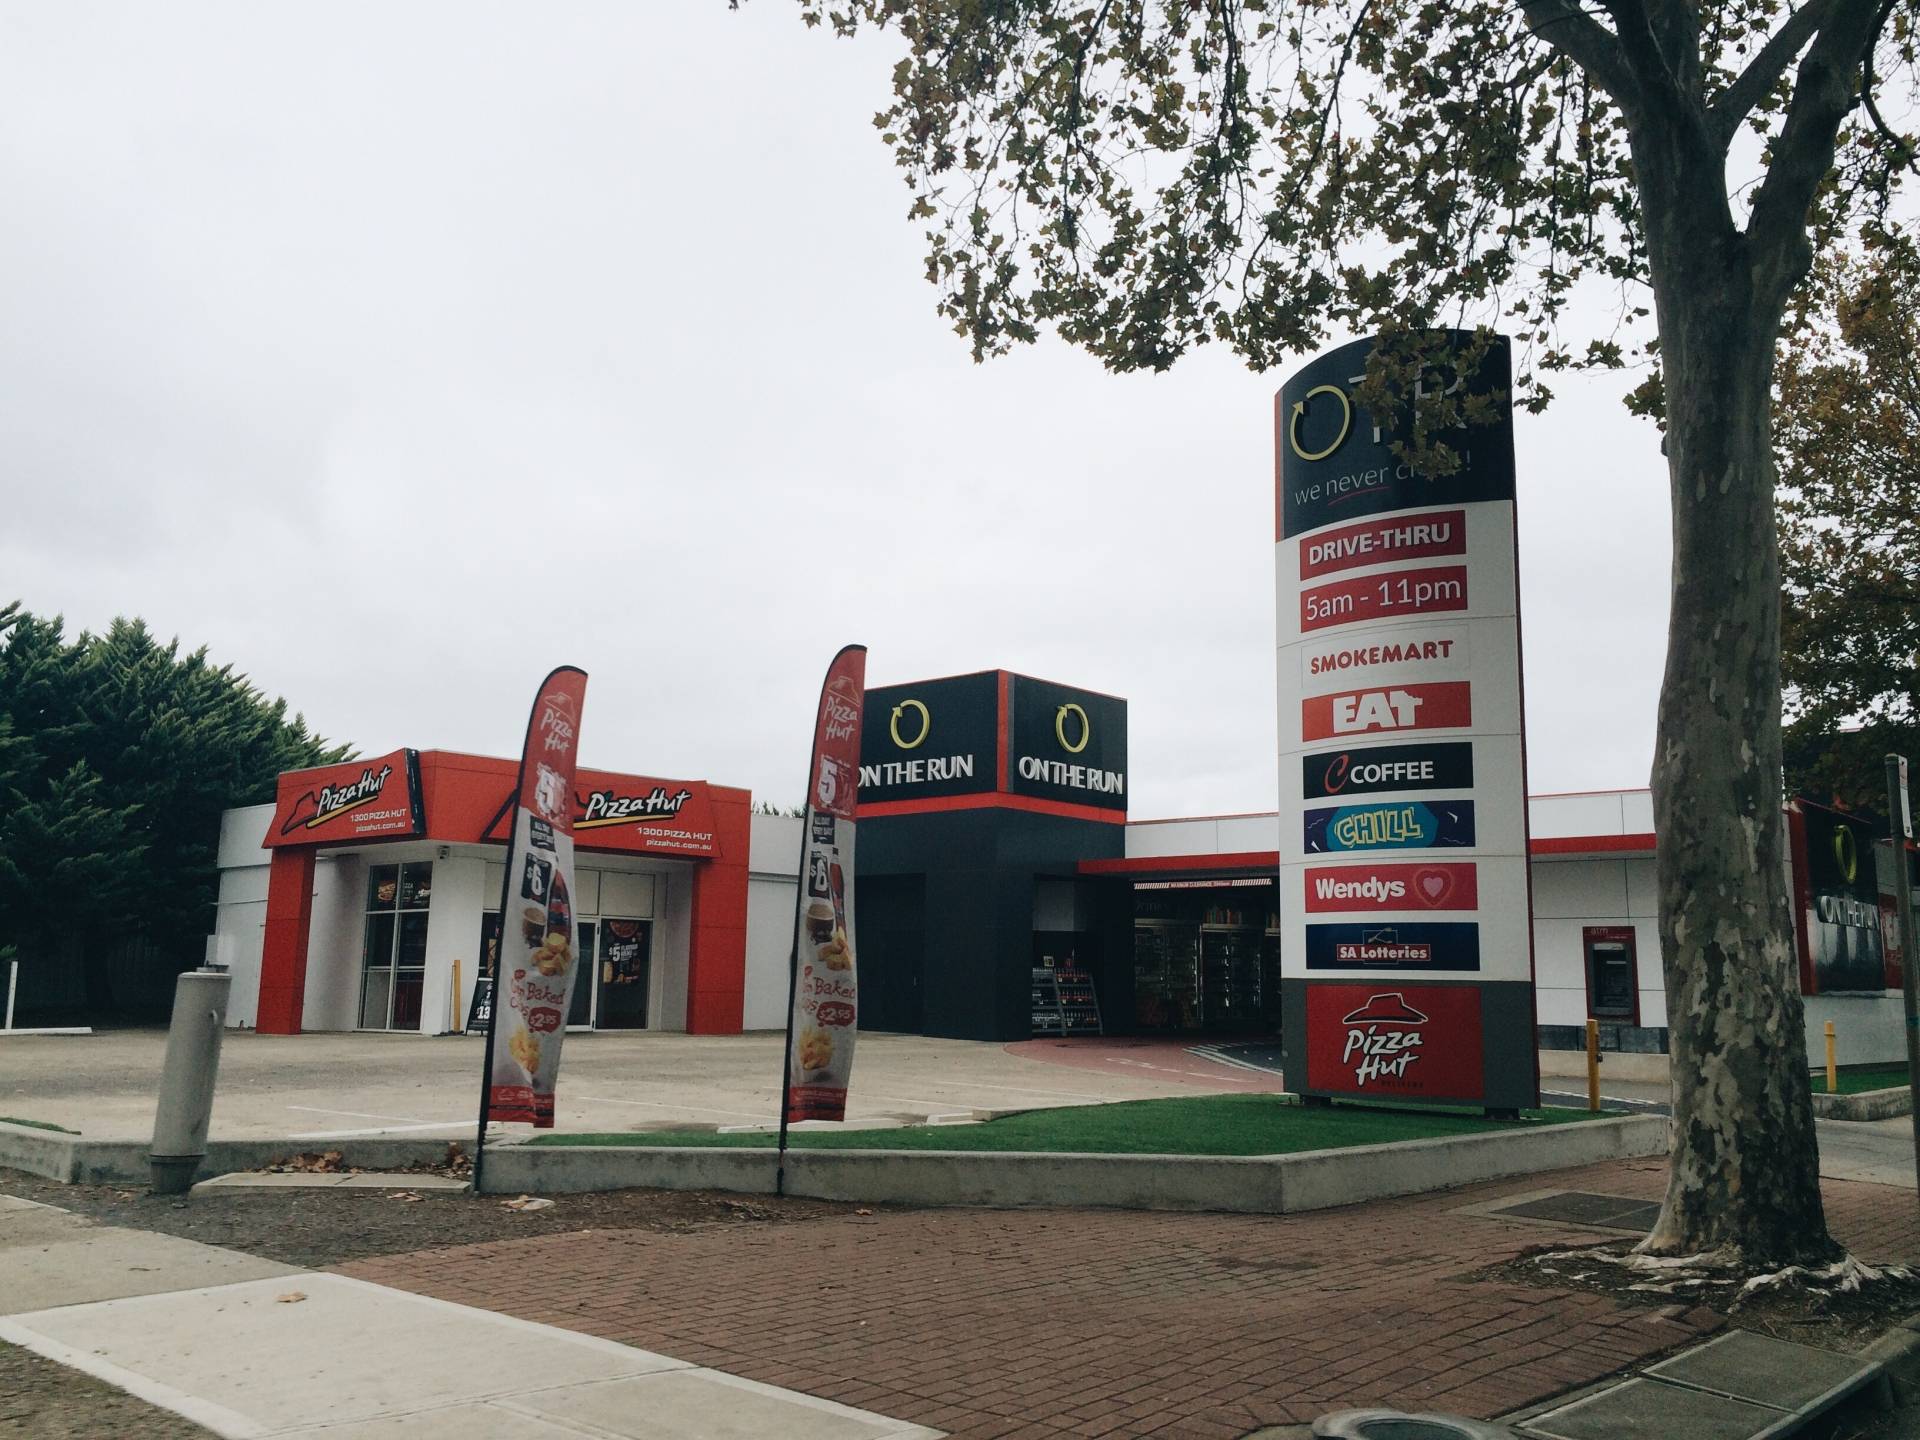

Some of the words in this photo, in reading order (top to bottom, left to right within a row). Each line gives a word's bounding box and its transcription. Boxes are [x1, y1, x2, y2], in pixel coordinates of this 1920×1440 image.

[1295, 484, 1321, 505] we
[1326, 467, 1389, 497] never
[1309, 522, 1451, 566] DRIVE-THRU
[1306, 594, 1353, 621] 5am
[1378, 578, 1461, 607] 11pm
[1310, 640, 1454, 675] SMOKEMART
[540, 708, 574, 739] Pizza
[823, 696, 858, 723] Pizza
[1333, 690, 1424, 734] EAT
[544, 731, 570, 752] Hut
[825, 720, 856, 742] Hut
[1350, 760, 1434, 784] COFFEE
[317, 783, 358, 818] Pizza
[358, 765, 392, 798] Hut
[585, 790, 643, 820] Pizza
[647, 787, 692, 813] Hut
[350, 812, 369, 822] 1300
[391, 808, 407, 817] HUT
[1334, 807, 1424, 848] CHILL
[637, 827, 662, 836] 1300
[664, 829, 691, 839] PIZZA
[693, 832, 712, 840] HUT
[646, 839, 712, 851] pizzahut.com.au
[1316, 876, 1405, 903] Wendys
[1340, 946, 1357, 959] SA
[1360, 945, 1427, 959] Lotteries
[527, 982, 566, 1005] Baked
[1342, 1025, 1423, 1064] Pizza
[1356, 1051, 1419, 1087] Hut
